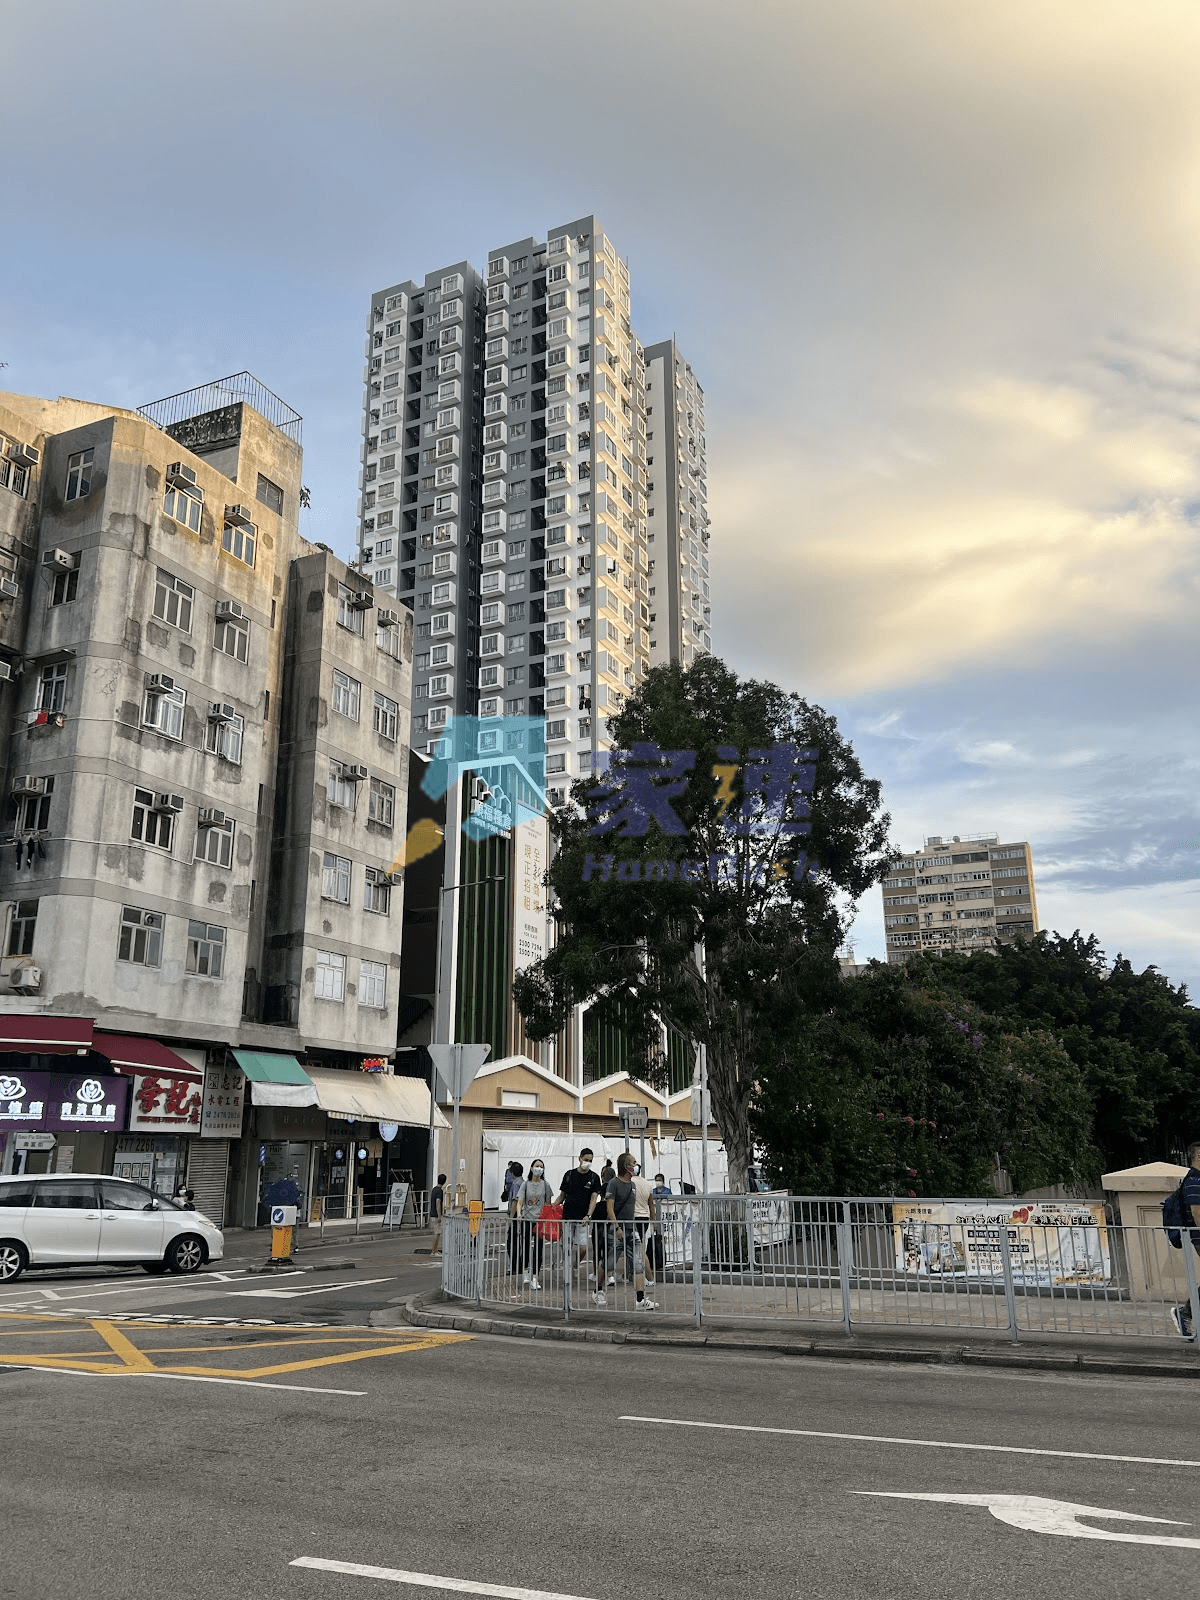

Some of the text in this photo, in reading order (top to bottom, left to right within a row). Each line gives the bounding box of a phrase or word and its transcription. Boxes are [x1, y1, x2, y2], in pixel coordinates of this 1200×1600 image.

[207, 1094, 240, 1107] 水電工程
[136, 1137, 155, 1152] 2266
